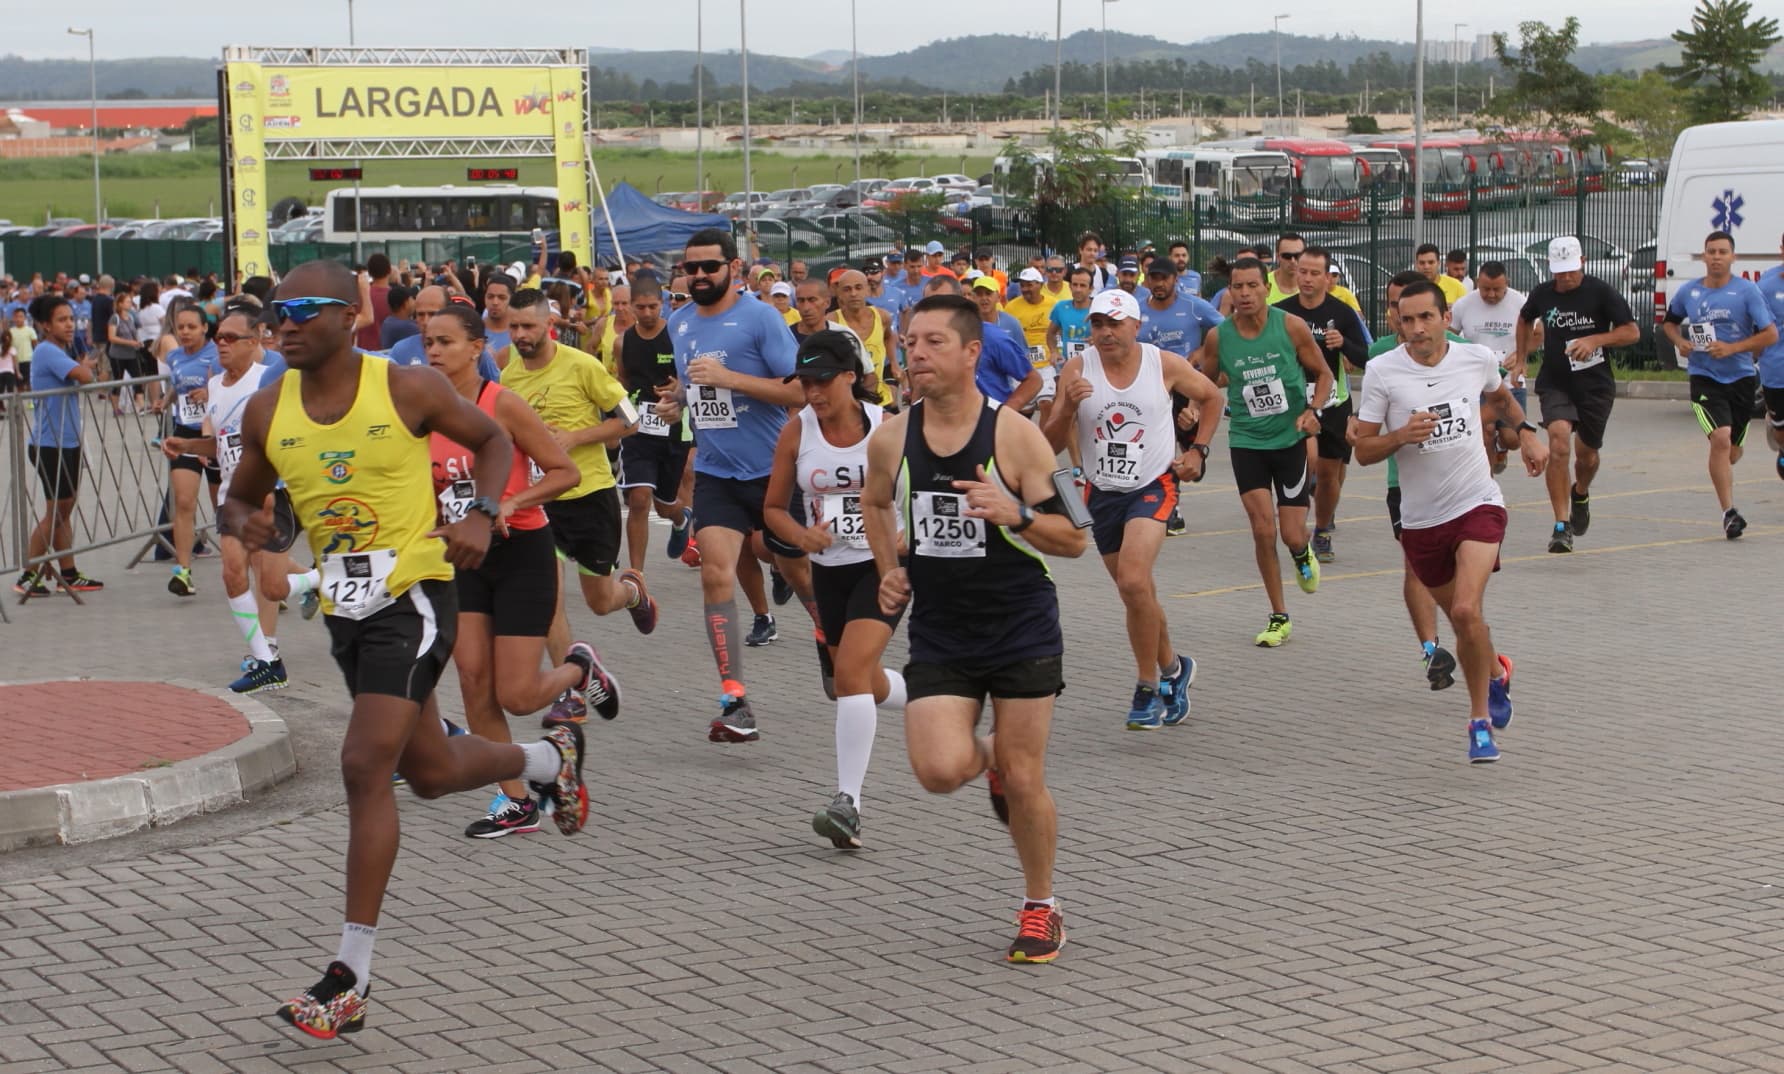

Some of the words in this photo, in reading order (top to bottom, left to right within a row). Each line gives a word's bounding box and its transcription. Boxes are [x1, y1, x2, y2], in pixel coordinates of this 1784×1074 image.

[315, 86, 503, 118] LARGADA
[692, 401, 730, 417] 1208
[1249, 394, 1283, 409] 1303
[1432, 417, 1466, 438] 073
[1098, 456, 1137, 475] 1127
[830, 516, 866, 534] 132
[919, 517, 977, 540] 1250
[934, 540, 962, 548] MARCO
